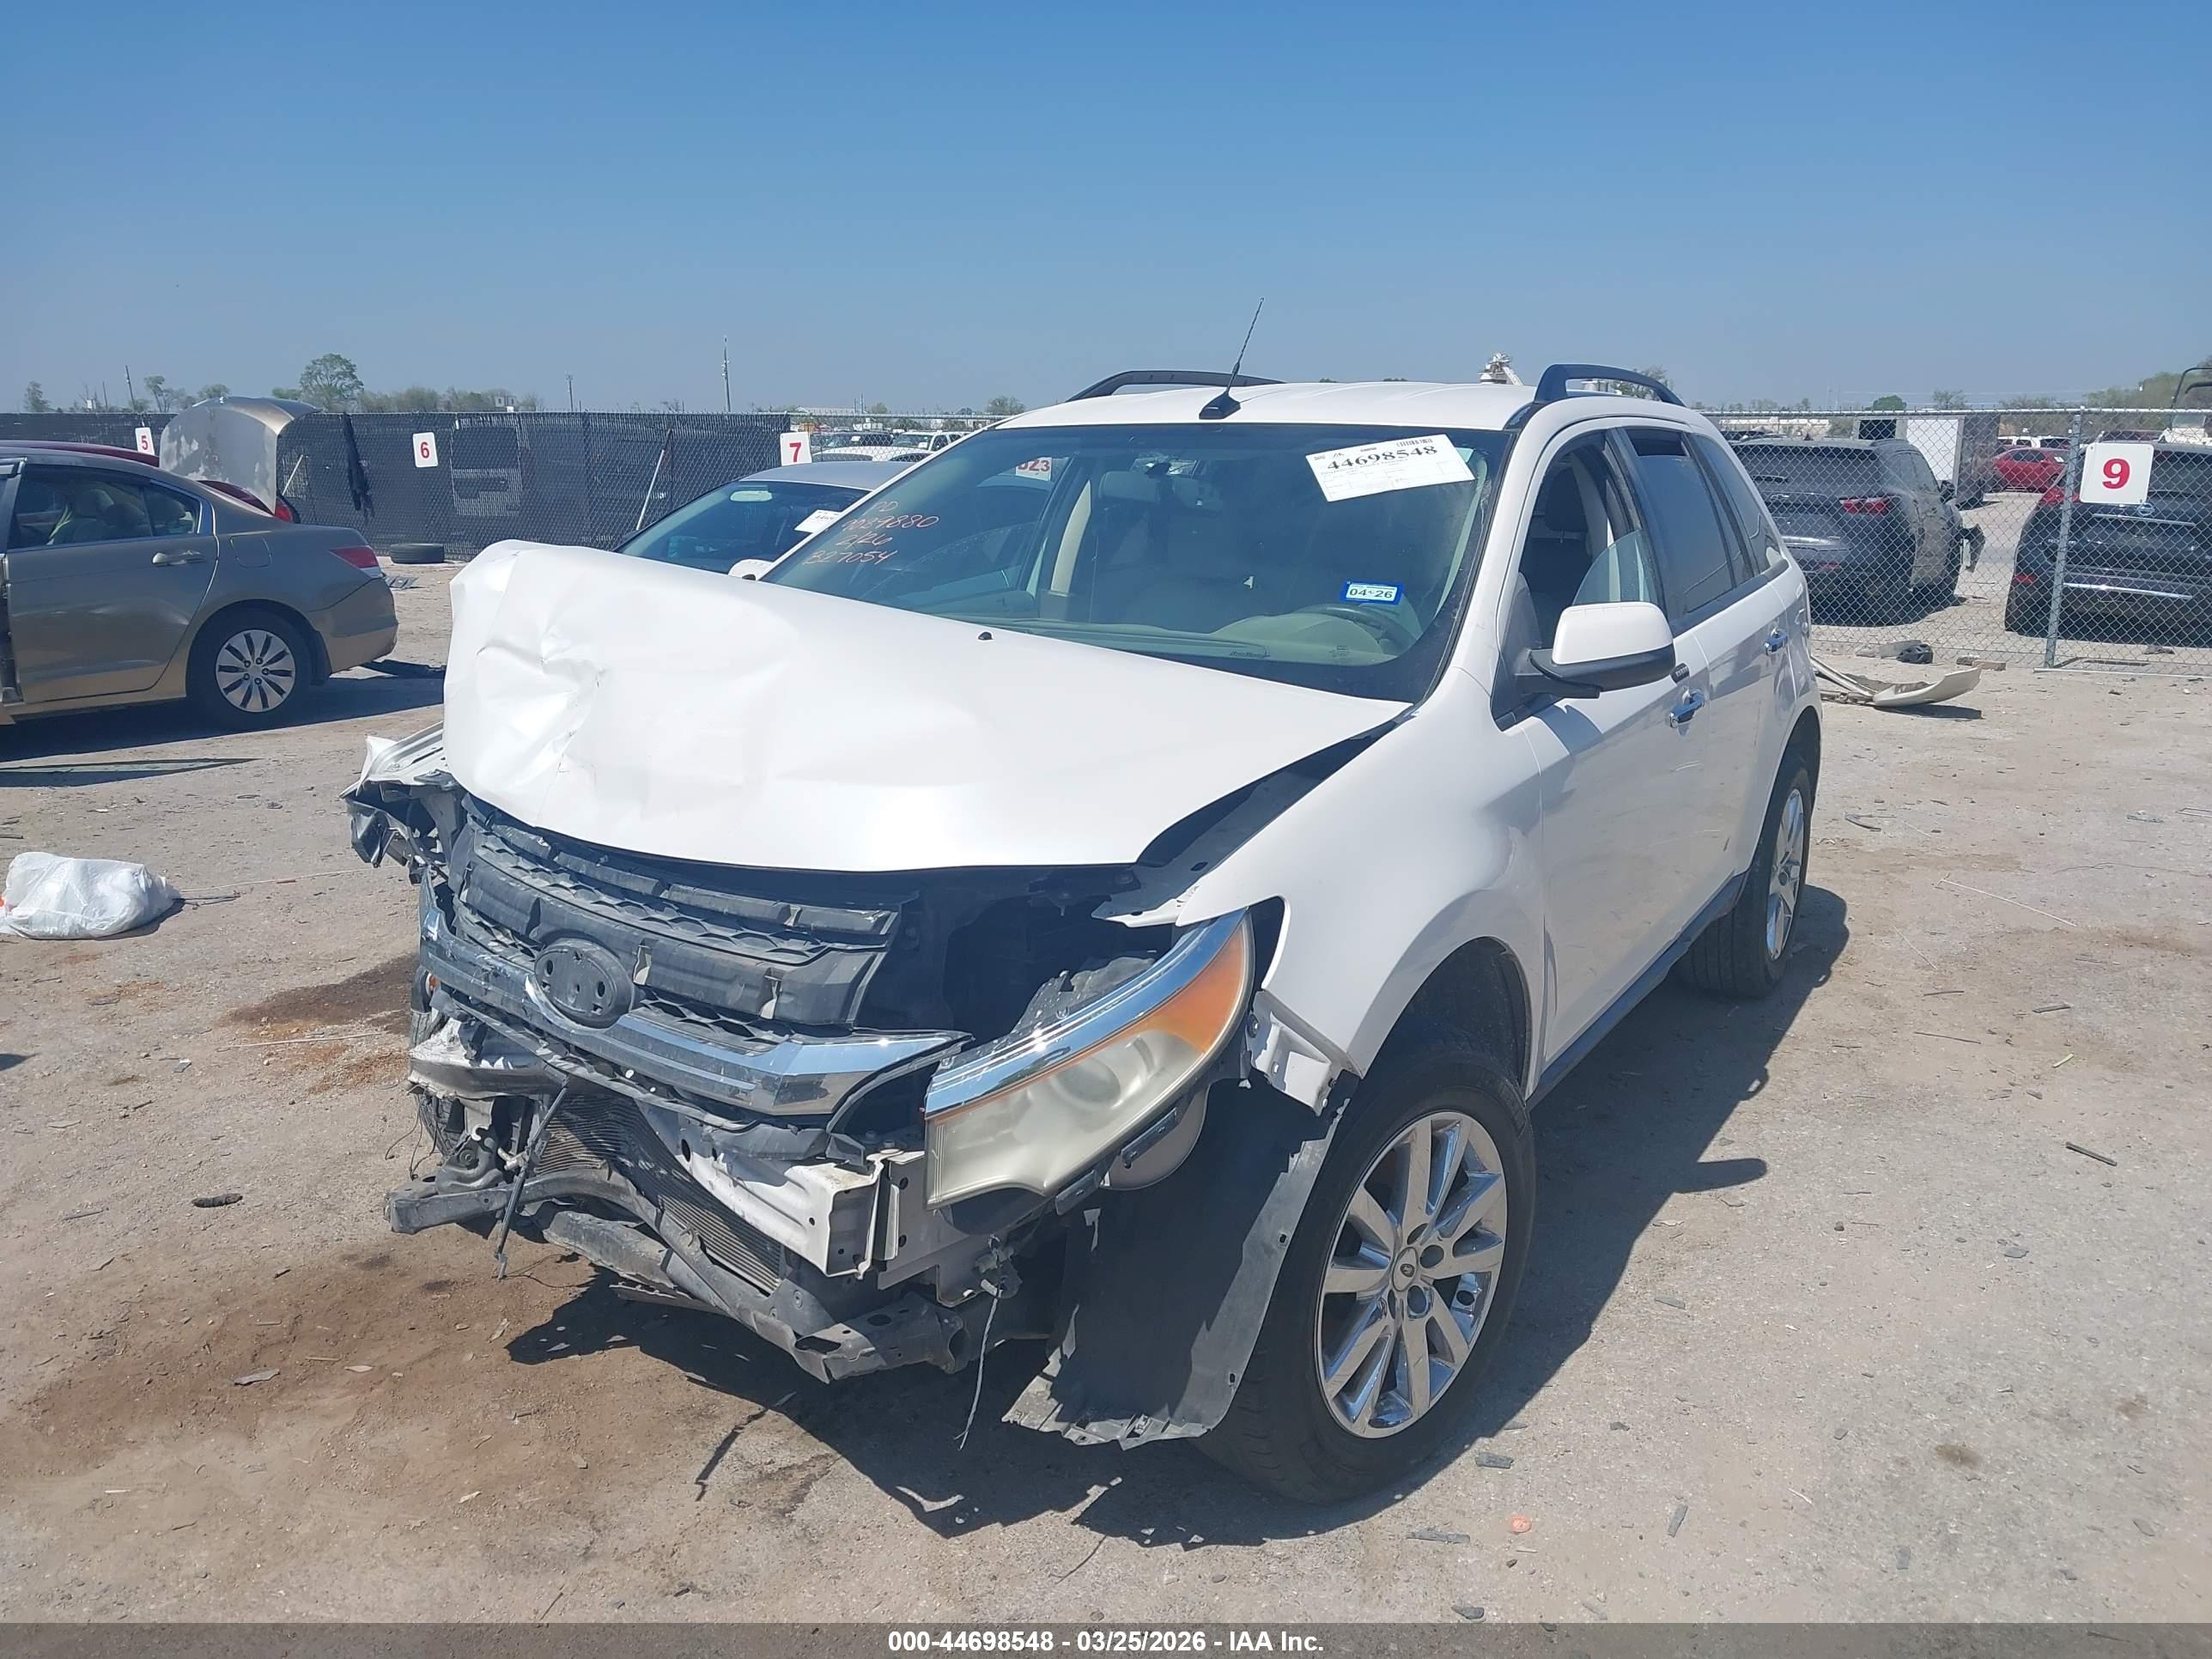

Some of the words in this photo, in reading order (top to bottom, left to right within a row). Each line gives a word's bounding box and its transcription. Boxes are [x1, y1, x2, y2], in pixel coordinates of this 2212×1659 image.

[141, 434, 149, 451] 5
[421, 441, 430, 459] 6
[789, 441, 802, 463] 7
[1327, 445, 1438, 471] 44698548
[2102, 458, 2130, 489] 9
